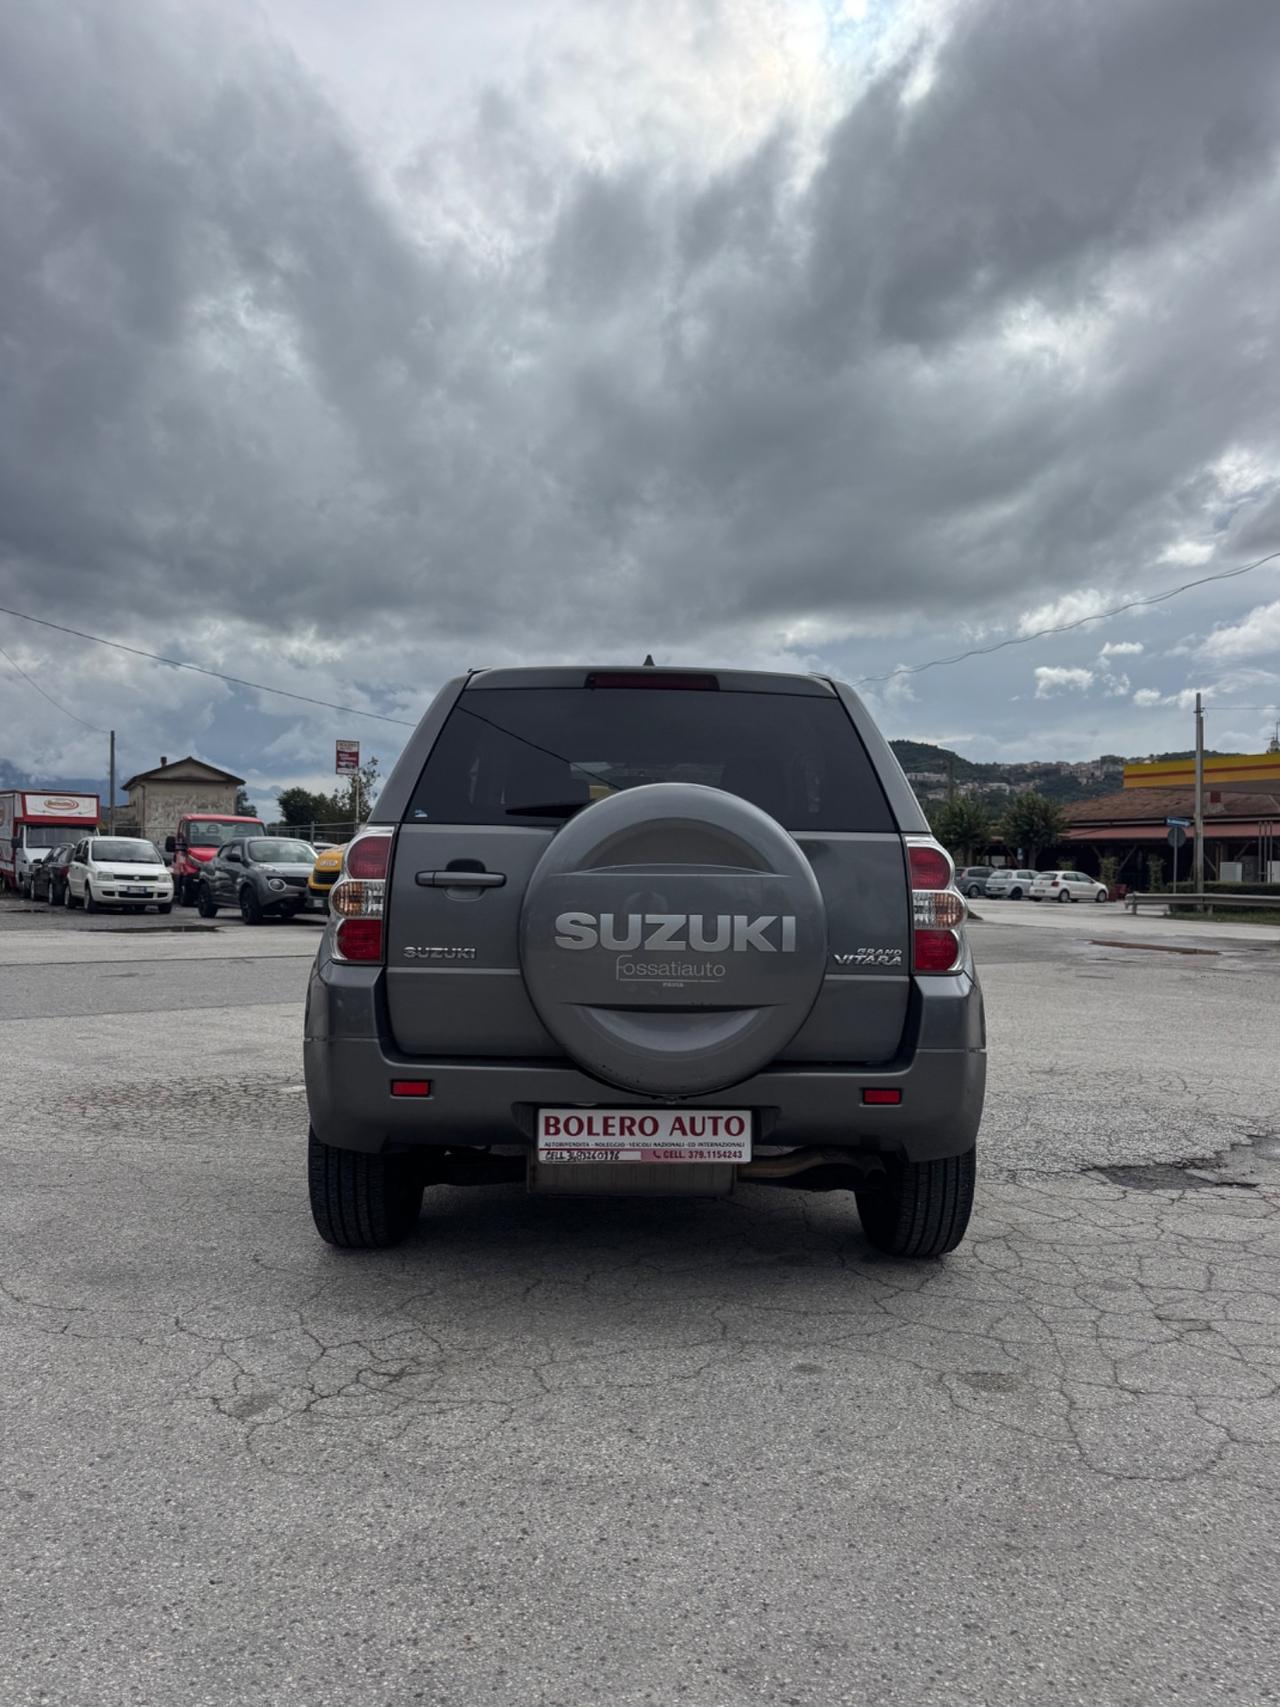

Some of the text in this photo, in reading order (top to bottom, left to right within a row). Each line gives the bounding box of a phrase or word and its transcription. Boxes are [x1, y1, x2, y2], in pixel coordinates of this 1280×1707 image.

[555, 912, 796, 953] SUZUKI
[403, 946, 476, 959] SUZUKI
[834, 954, 902, 965] VITARA
[543, 1115, 746, 1137] BOLERO AUTO
[688, 1150, 743, 1159] 379.1154243
